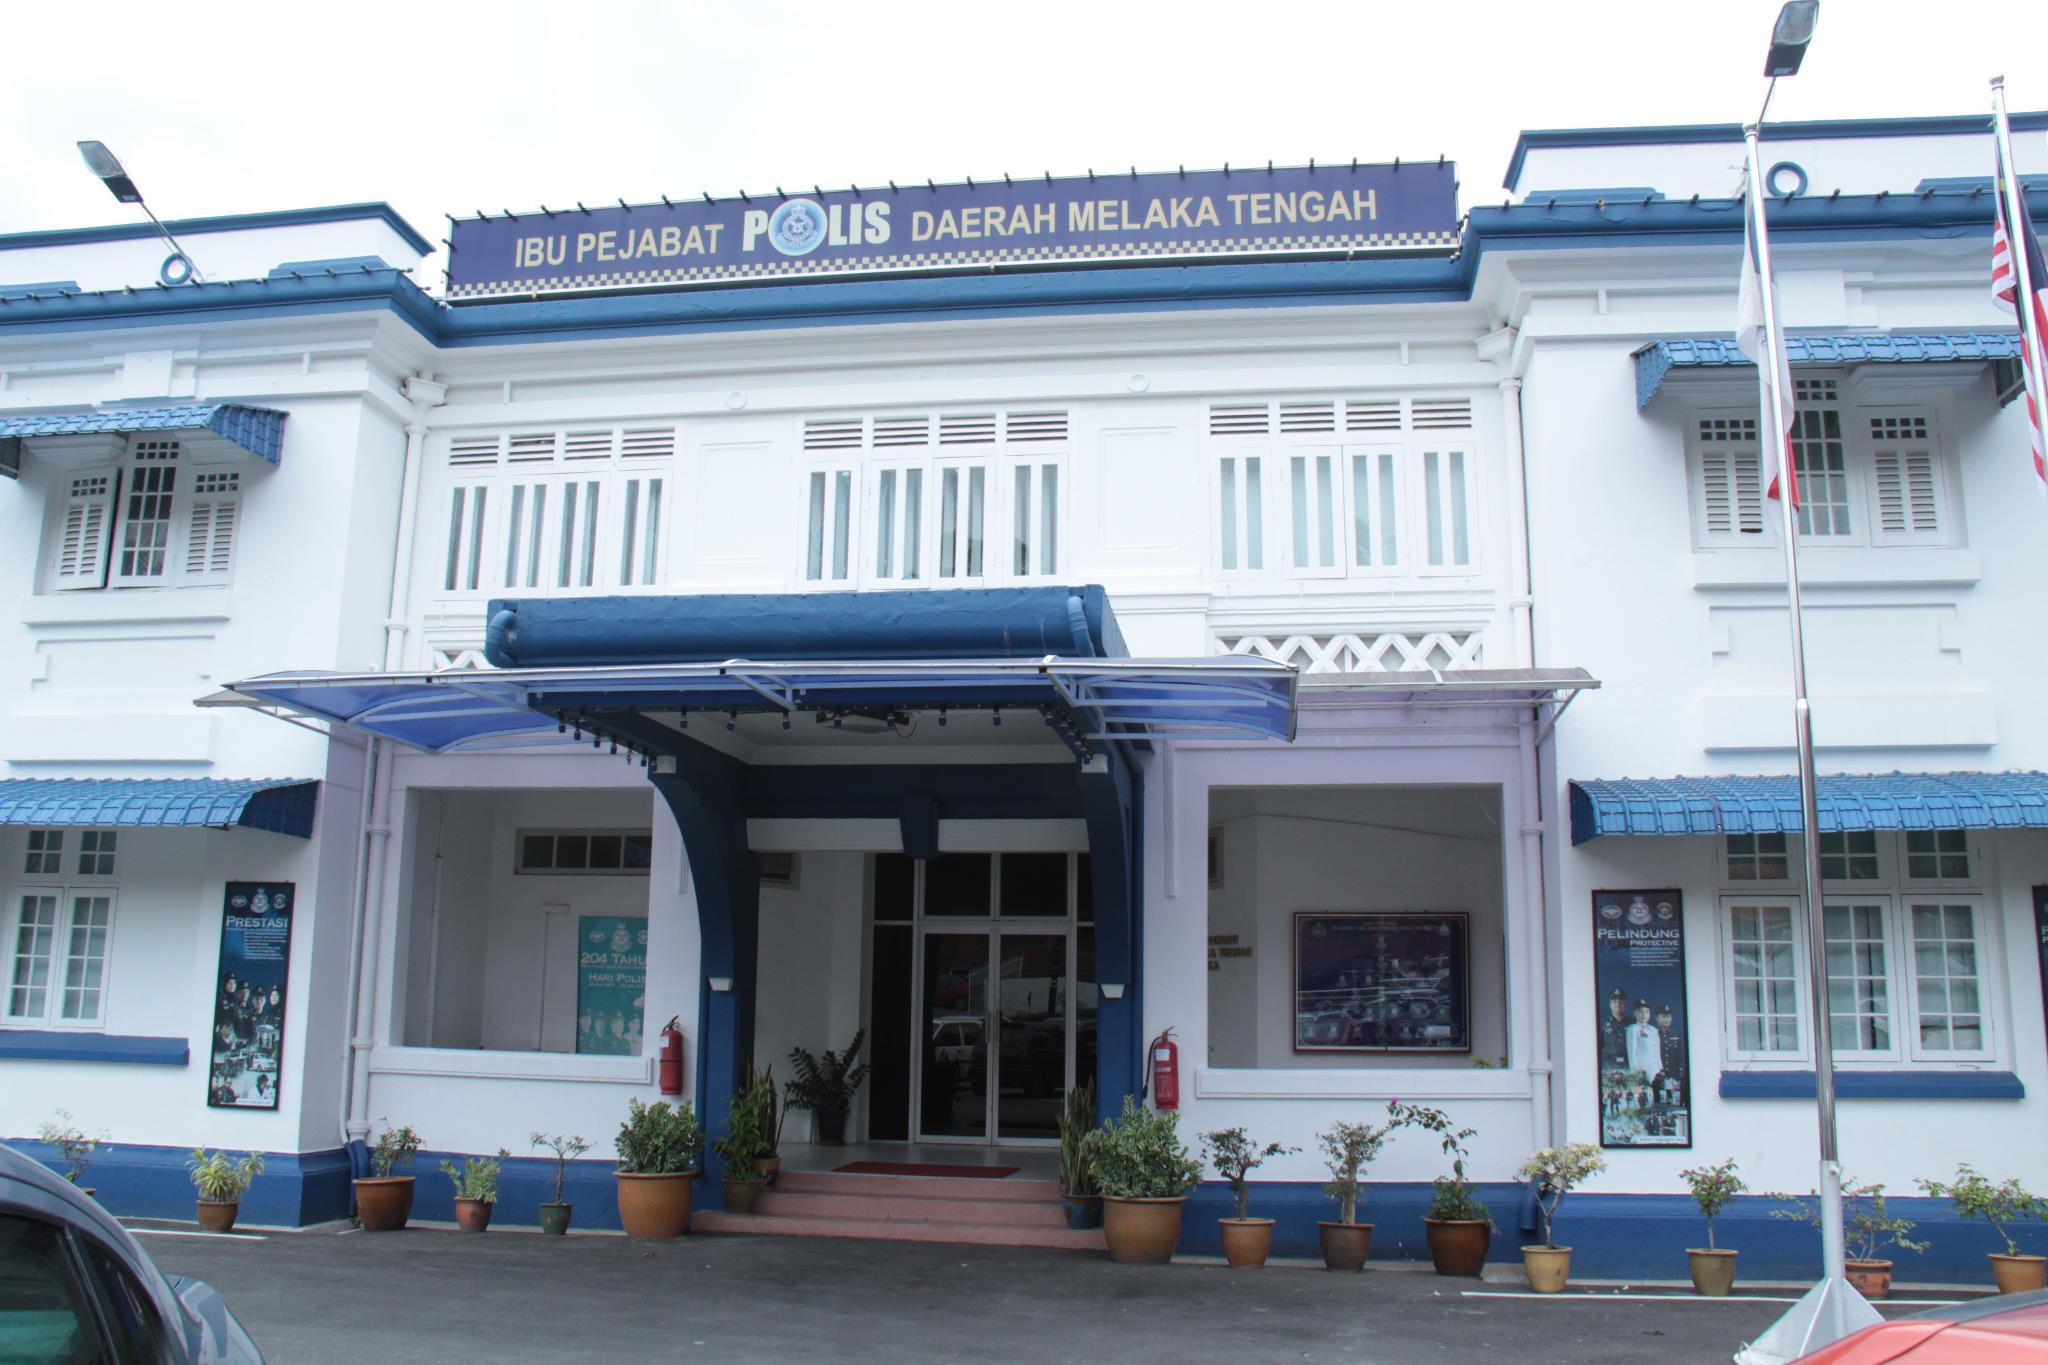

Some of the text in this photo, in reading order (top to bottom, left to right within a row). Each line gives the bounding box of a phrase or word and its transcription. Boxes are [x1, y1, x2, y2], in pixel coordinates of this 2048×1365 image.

[514, 189, 1378, 268] IBU PEJABAT POLIS DAERAH MELAKA TENGAH
[225, 915, 288, 928] PRESTASI
[1597, 928, 1680, 939] PELINDUNG
[581, 953, 607, 963] 204
[589, 973, 613, 982] HARI
